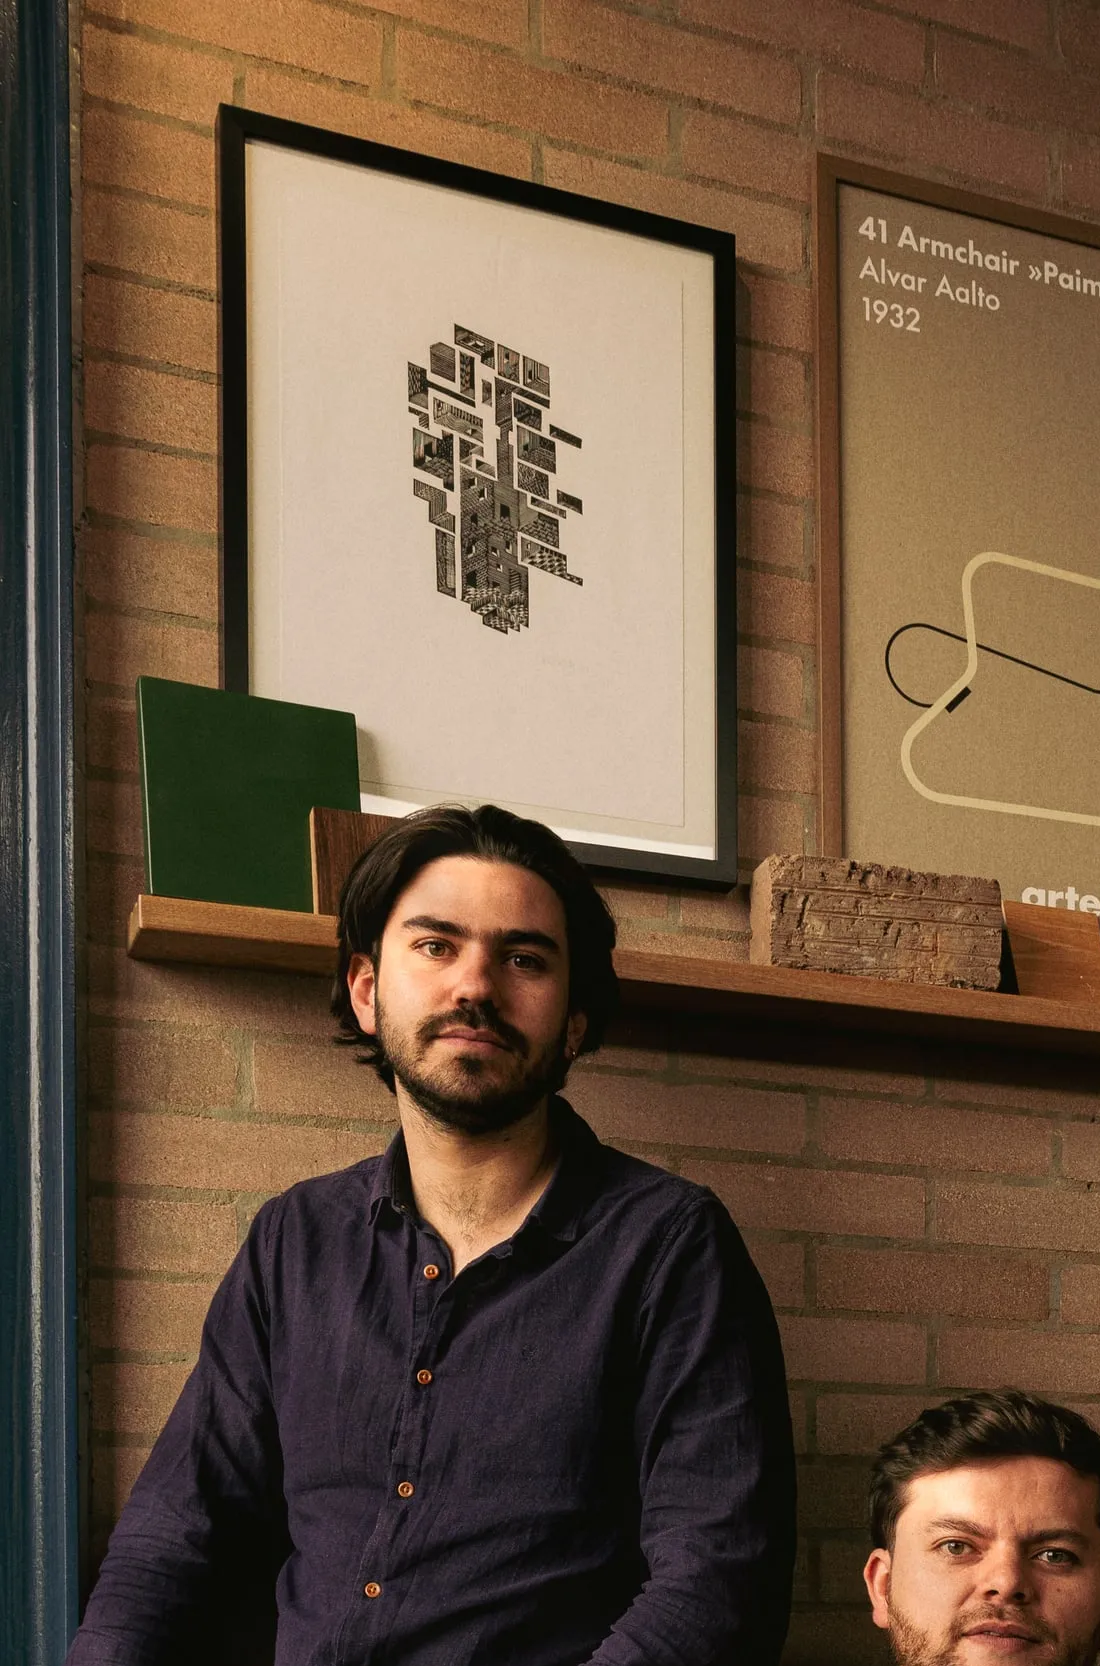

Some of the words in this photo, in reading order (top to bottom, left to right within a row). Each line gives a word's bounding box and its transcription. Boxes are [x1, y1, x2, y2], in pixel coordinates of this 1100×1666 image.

[858, 216, 888, 244] 41
[897, 225, 1020, 276] Armchair
[859, 256, 928, 293] Alvar
[935, 274, 1001, 311] Aalto
[862, 296, 921, 333] 1932
